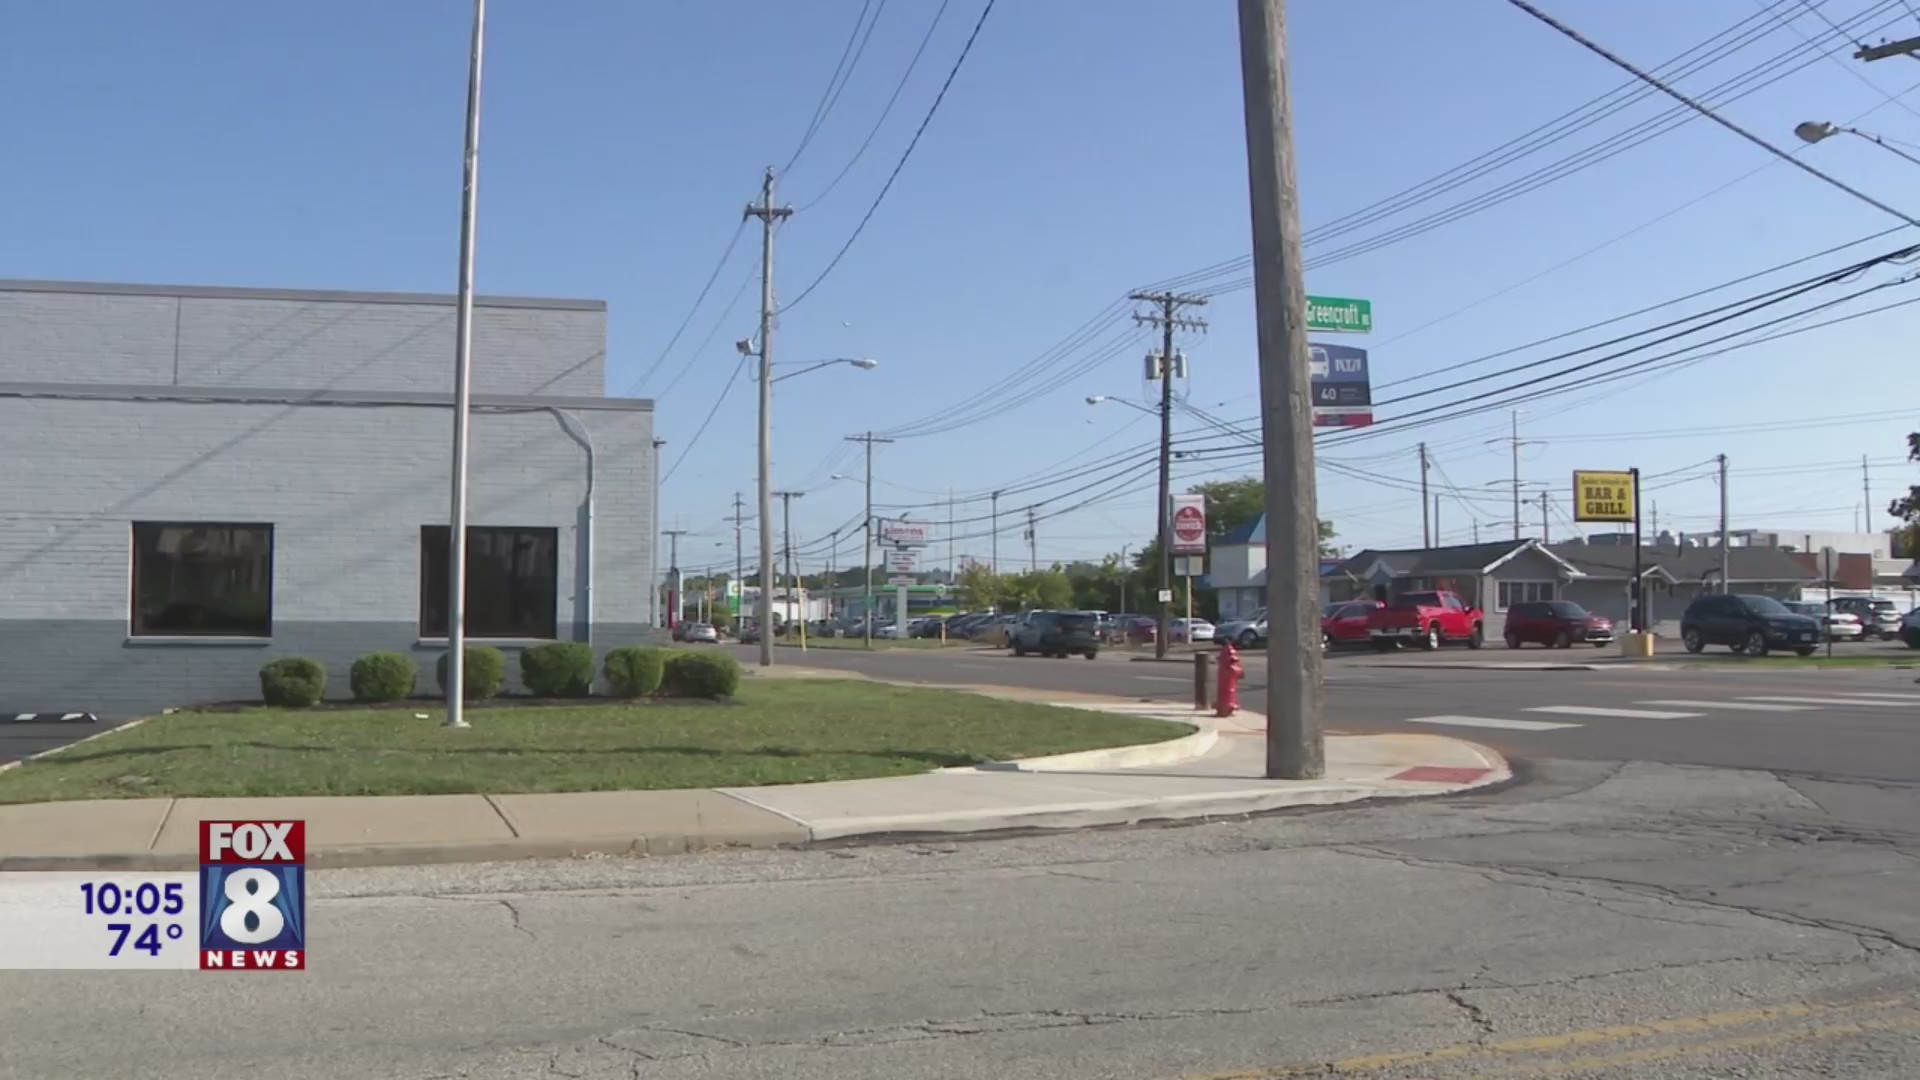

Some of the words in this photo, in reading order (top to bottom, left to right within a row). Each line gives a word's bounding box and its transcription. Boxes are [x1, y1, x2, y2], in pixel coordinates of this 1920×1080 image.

[1321, 388, 1337, 400] 40
[1585, 487, 1612, 500] BAR
[1617, 487, 1626, 500] &
[1586, 502, 1626, 515] GRILL
